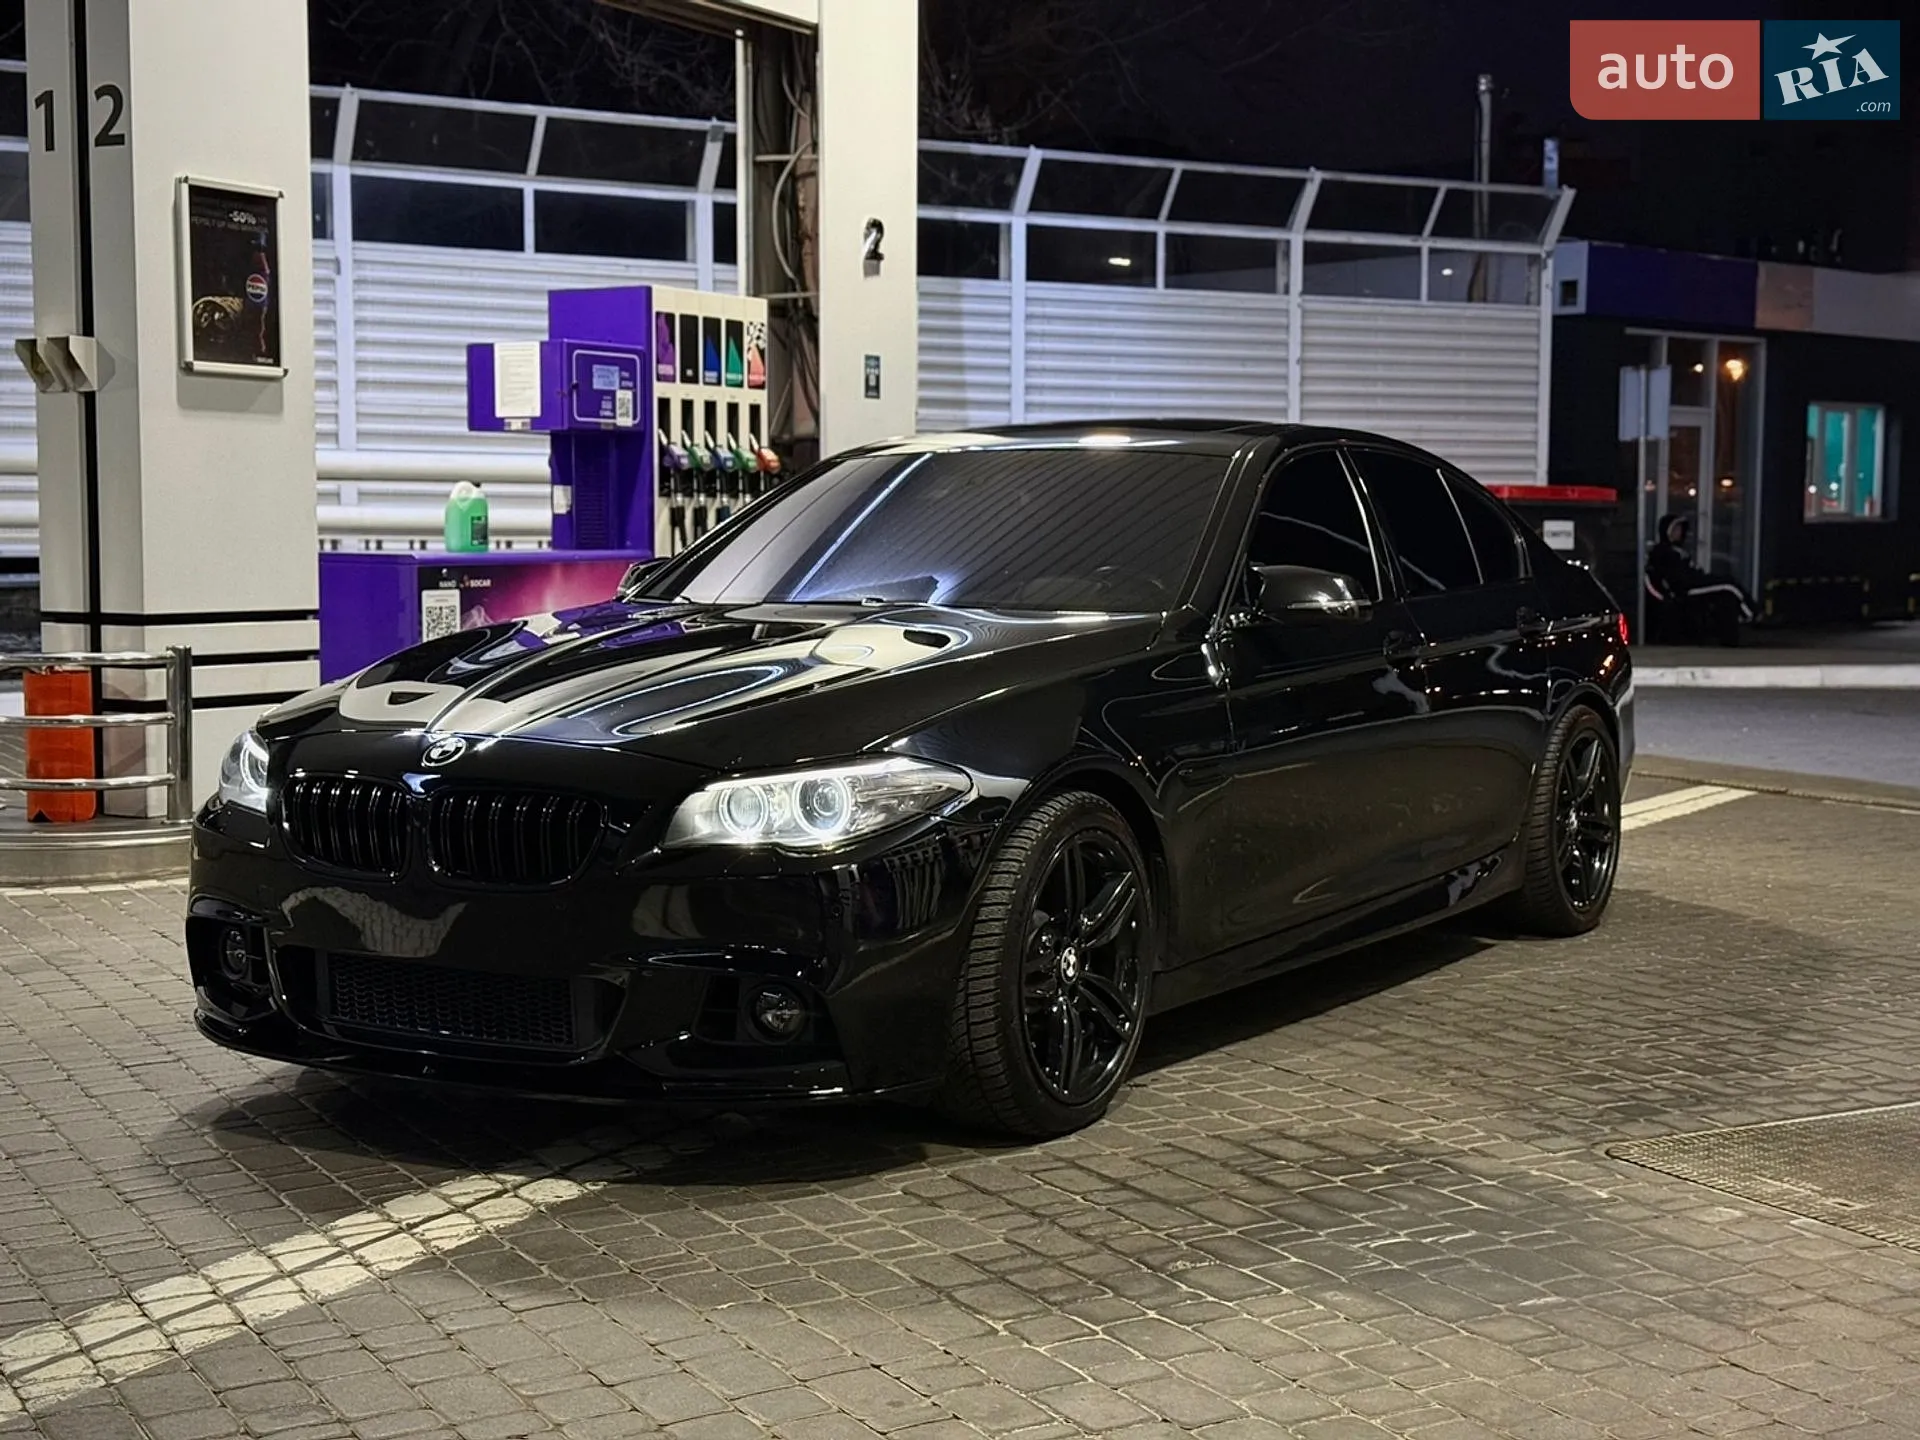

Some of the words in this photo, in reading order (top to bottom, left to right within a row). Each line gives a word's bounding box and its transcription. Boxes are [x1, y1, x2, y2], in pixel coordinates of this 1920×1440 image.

[34, 90, 55, 152] 1
[94, 84, 126, 148] 2
[863, 217, 885, 261] 2
